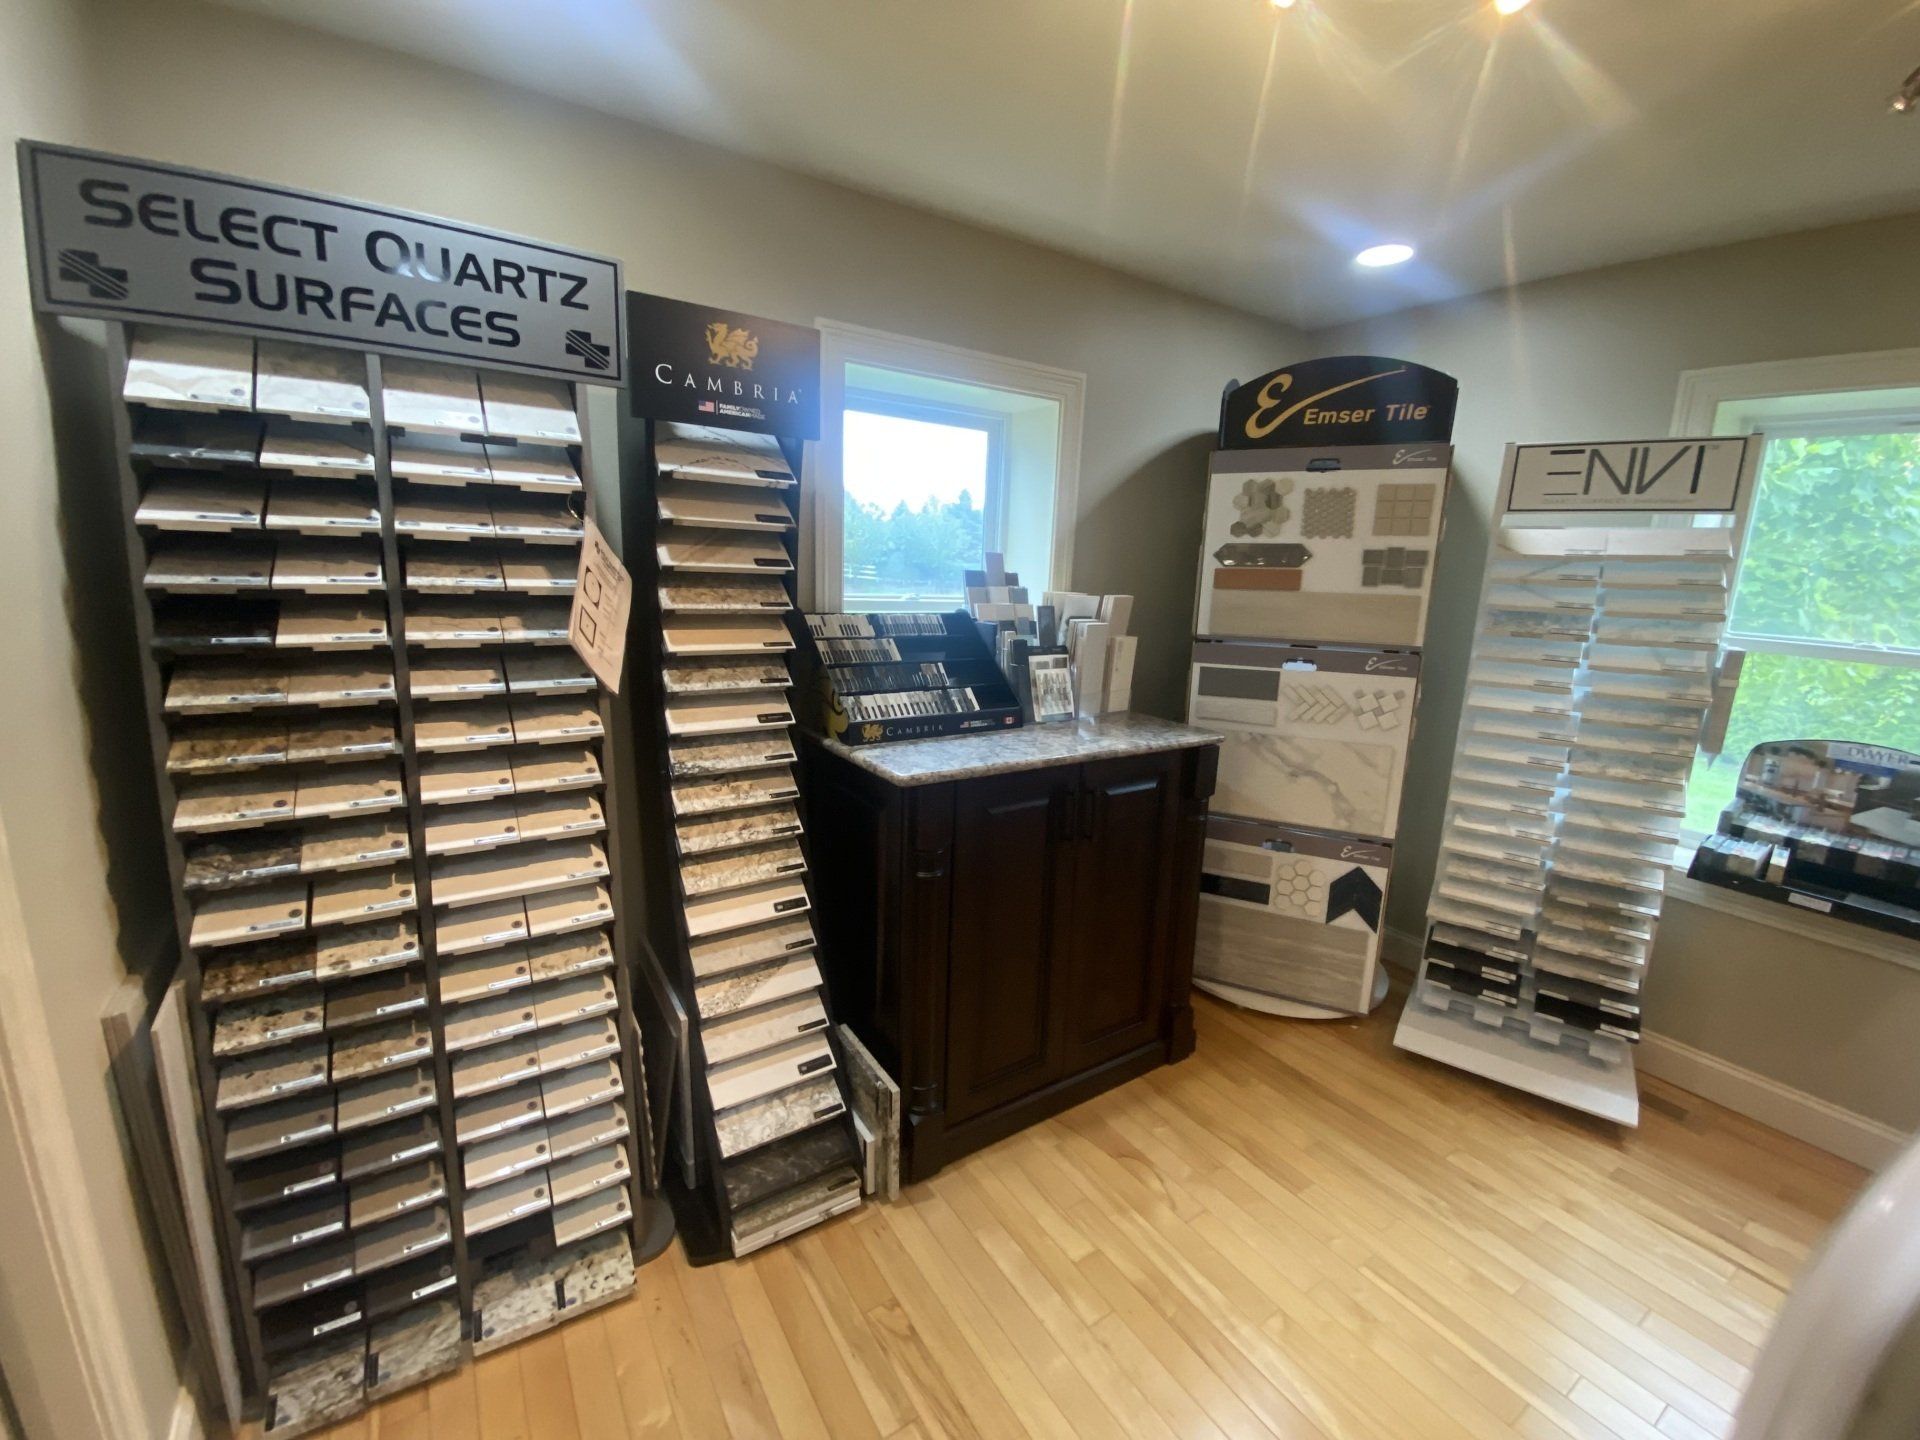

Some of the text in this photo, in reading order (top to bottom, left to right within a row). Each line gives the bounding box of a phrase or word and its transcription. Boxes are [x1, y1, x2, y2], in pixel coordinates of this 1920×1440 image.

[79, 178, 589, 311] SELECT QUARTZ
[190, 258, 521, 348] SURFACES
[655, 363, 798, 404] CAMBRIA
[1303, 403, 1428, 425] Emser Tile
[1543, 445, 1706, 495] ENVI
